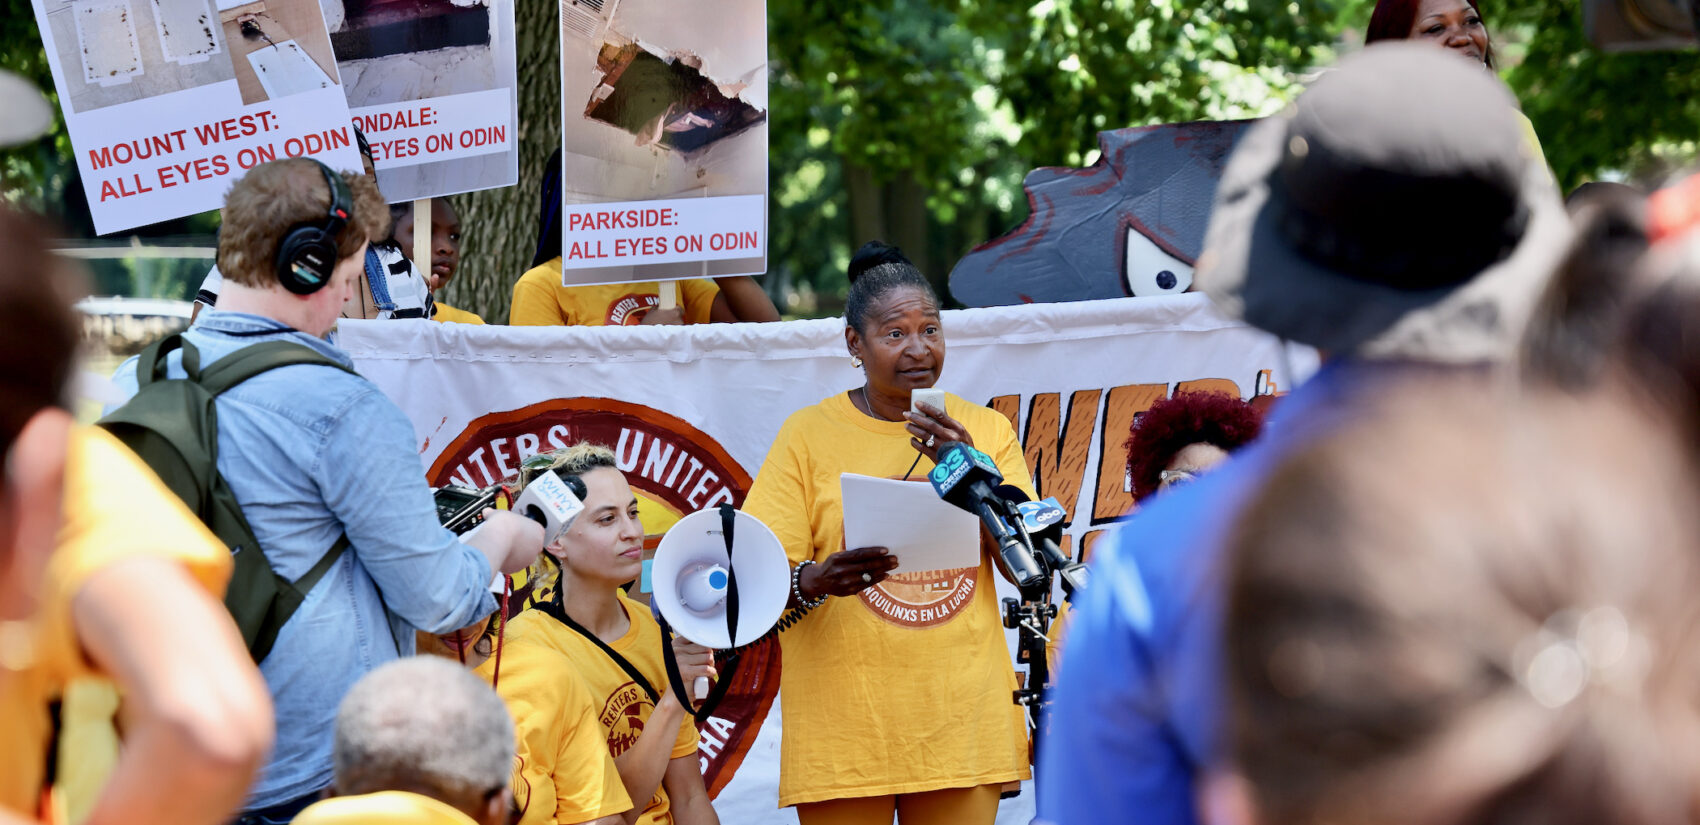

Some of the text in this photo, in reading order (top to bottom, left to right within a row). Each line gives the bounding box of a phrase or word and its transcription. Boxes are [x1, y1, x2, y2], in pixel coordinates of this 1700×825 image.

[88, 110, 280, 170] MOUNT WEST:
[369, 125, 506, 161] EYES ON ODIN
[100, 126, 351, 202] ALL EYES ON ODIN
[569, 208, 679, 231] PARKSIDE:
[568, 230, 758, 260] ALL EYES ON ODIN
[611, 298, 639, 324] RENTERS
[946, 448, 965, 471] 3
[1036, 508, 1061, 522] abc
[920, 608, 934, 622] EN
[935, 605, 950, 619] LA
[949, 577, 975, 611] LUCHA
[602, 688, 638, 728] RENTERS
